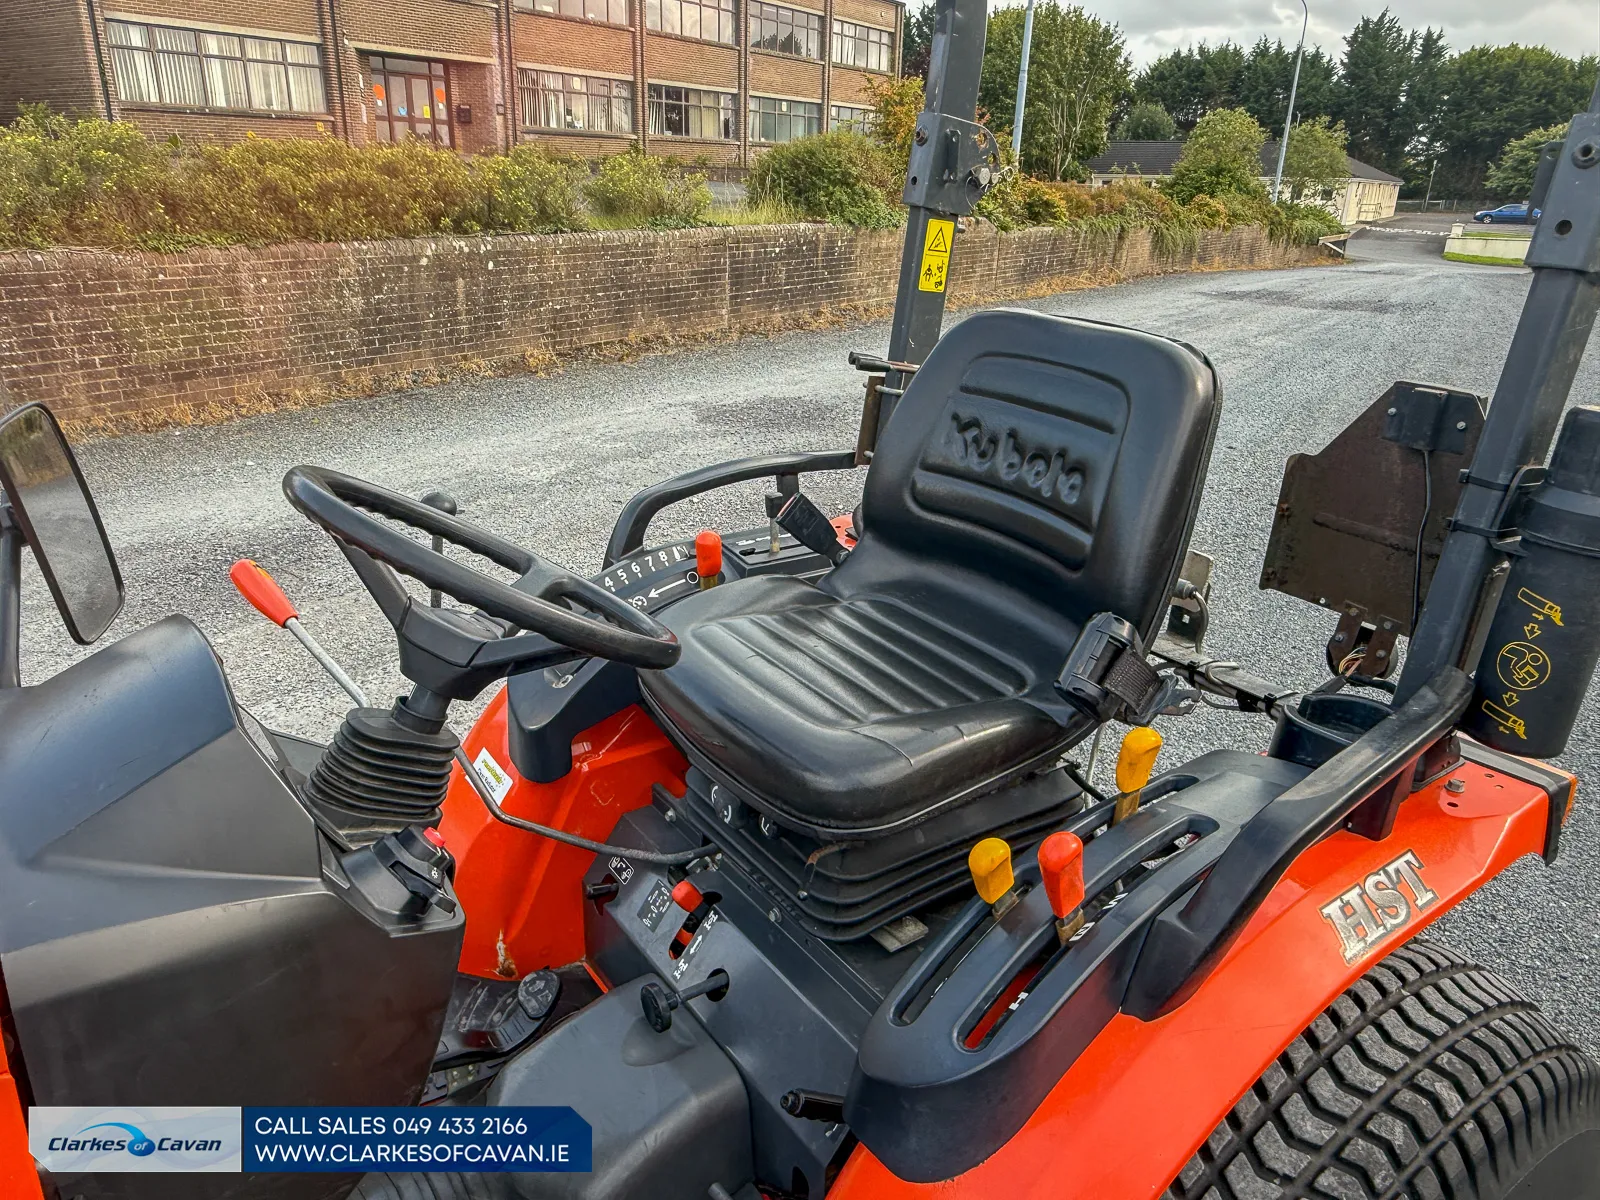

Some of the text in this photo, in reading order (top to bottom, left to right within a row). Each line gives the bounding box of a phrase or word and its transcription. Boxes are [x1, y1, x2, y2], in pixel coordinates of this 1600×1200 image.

[944, 411, 1086, 505] Kubota
[604, 550, 668, 587] 4 5 6 7 8
[1319, 848, 1439, 964] HST
